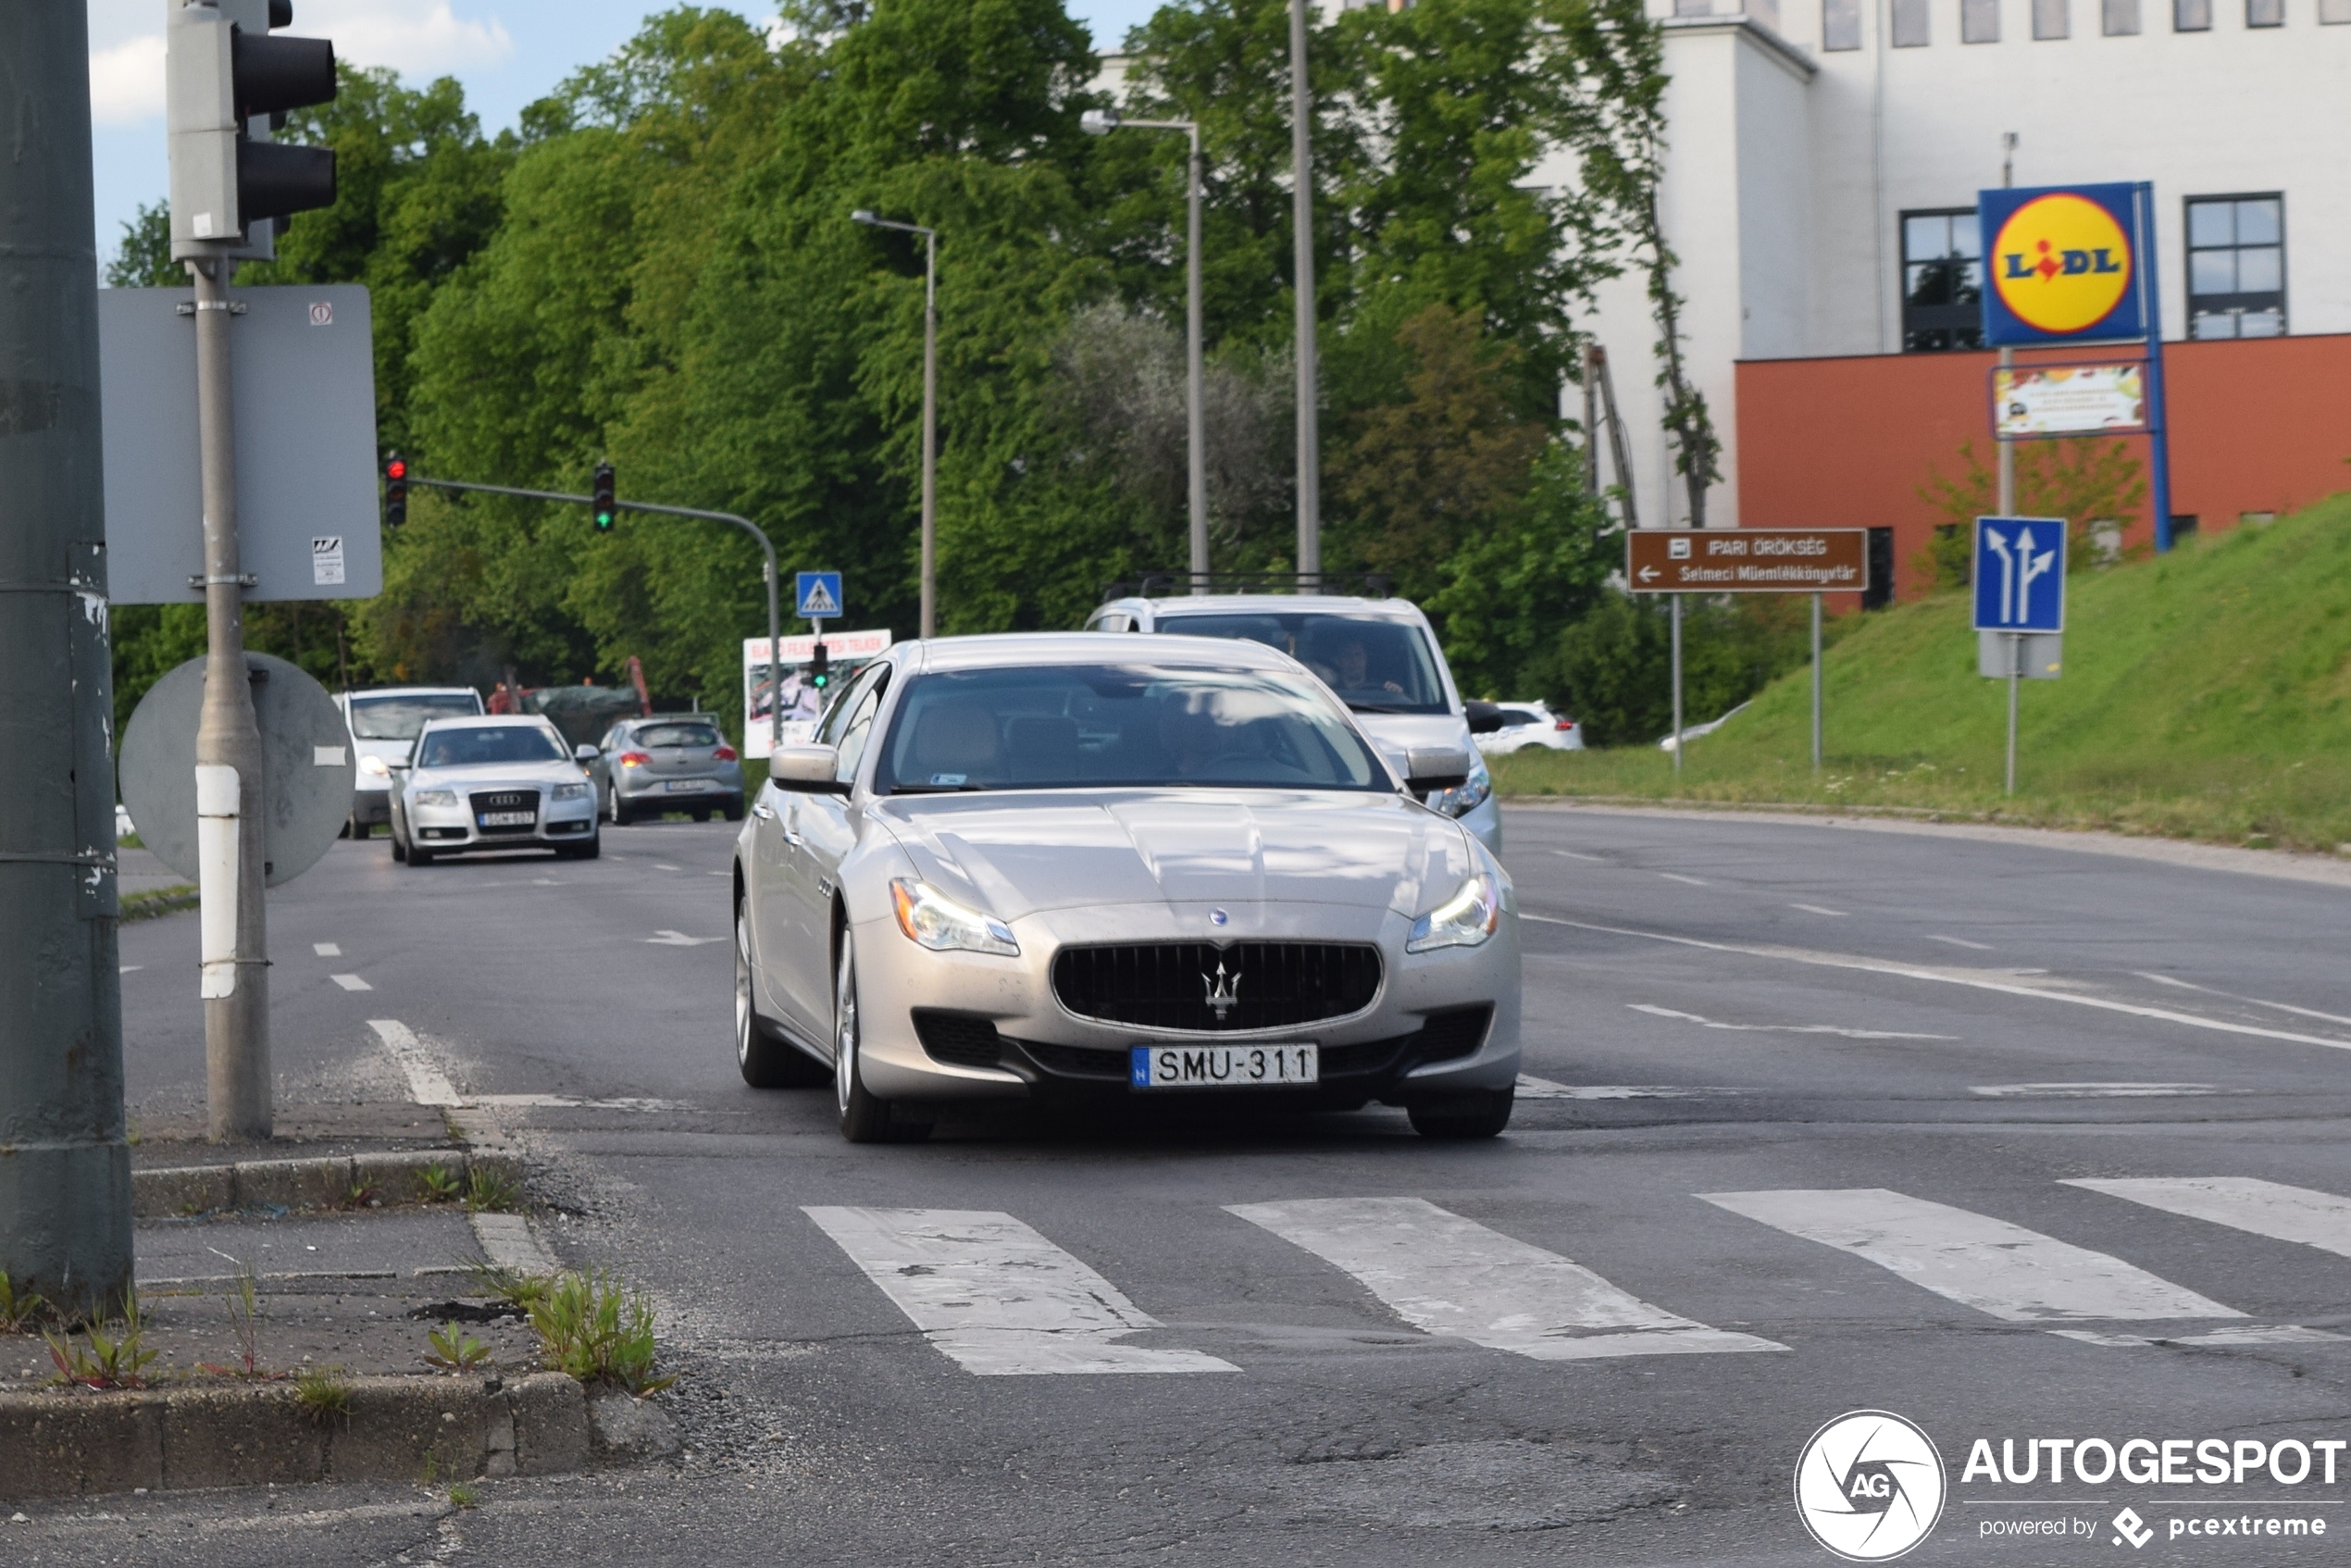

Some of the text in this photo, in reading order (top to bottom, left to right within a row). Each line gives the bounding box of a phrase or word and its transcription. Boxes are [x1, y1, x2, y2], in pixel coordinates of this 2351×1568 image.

[1709, 536, 1826, 555] IPARI ÖRÖKSÉG
[1679, 565, 1734, 581] Selmeci
[1159, 1050, 1306, 1080] SMU-311
